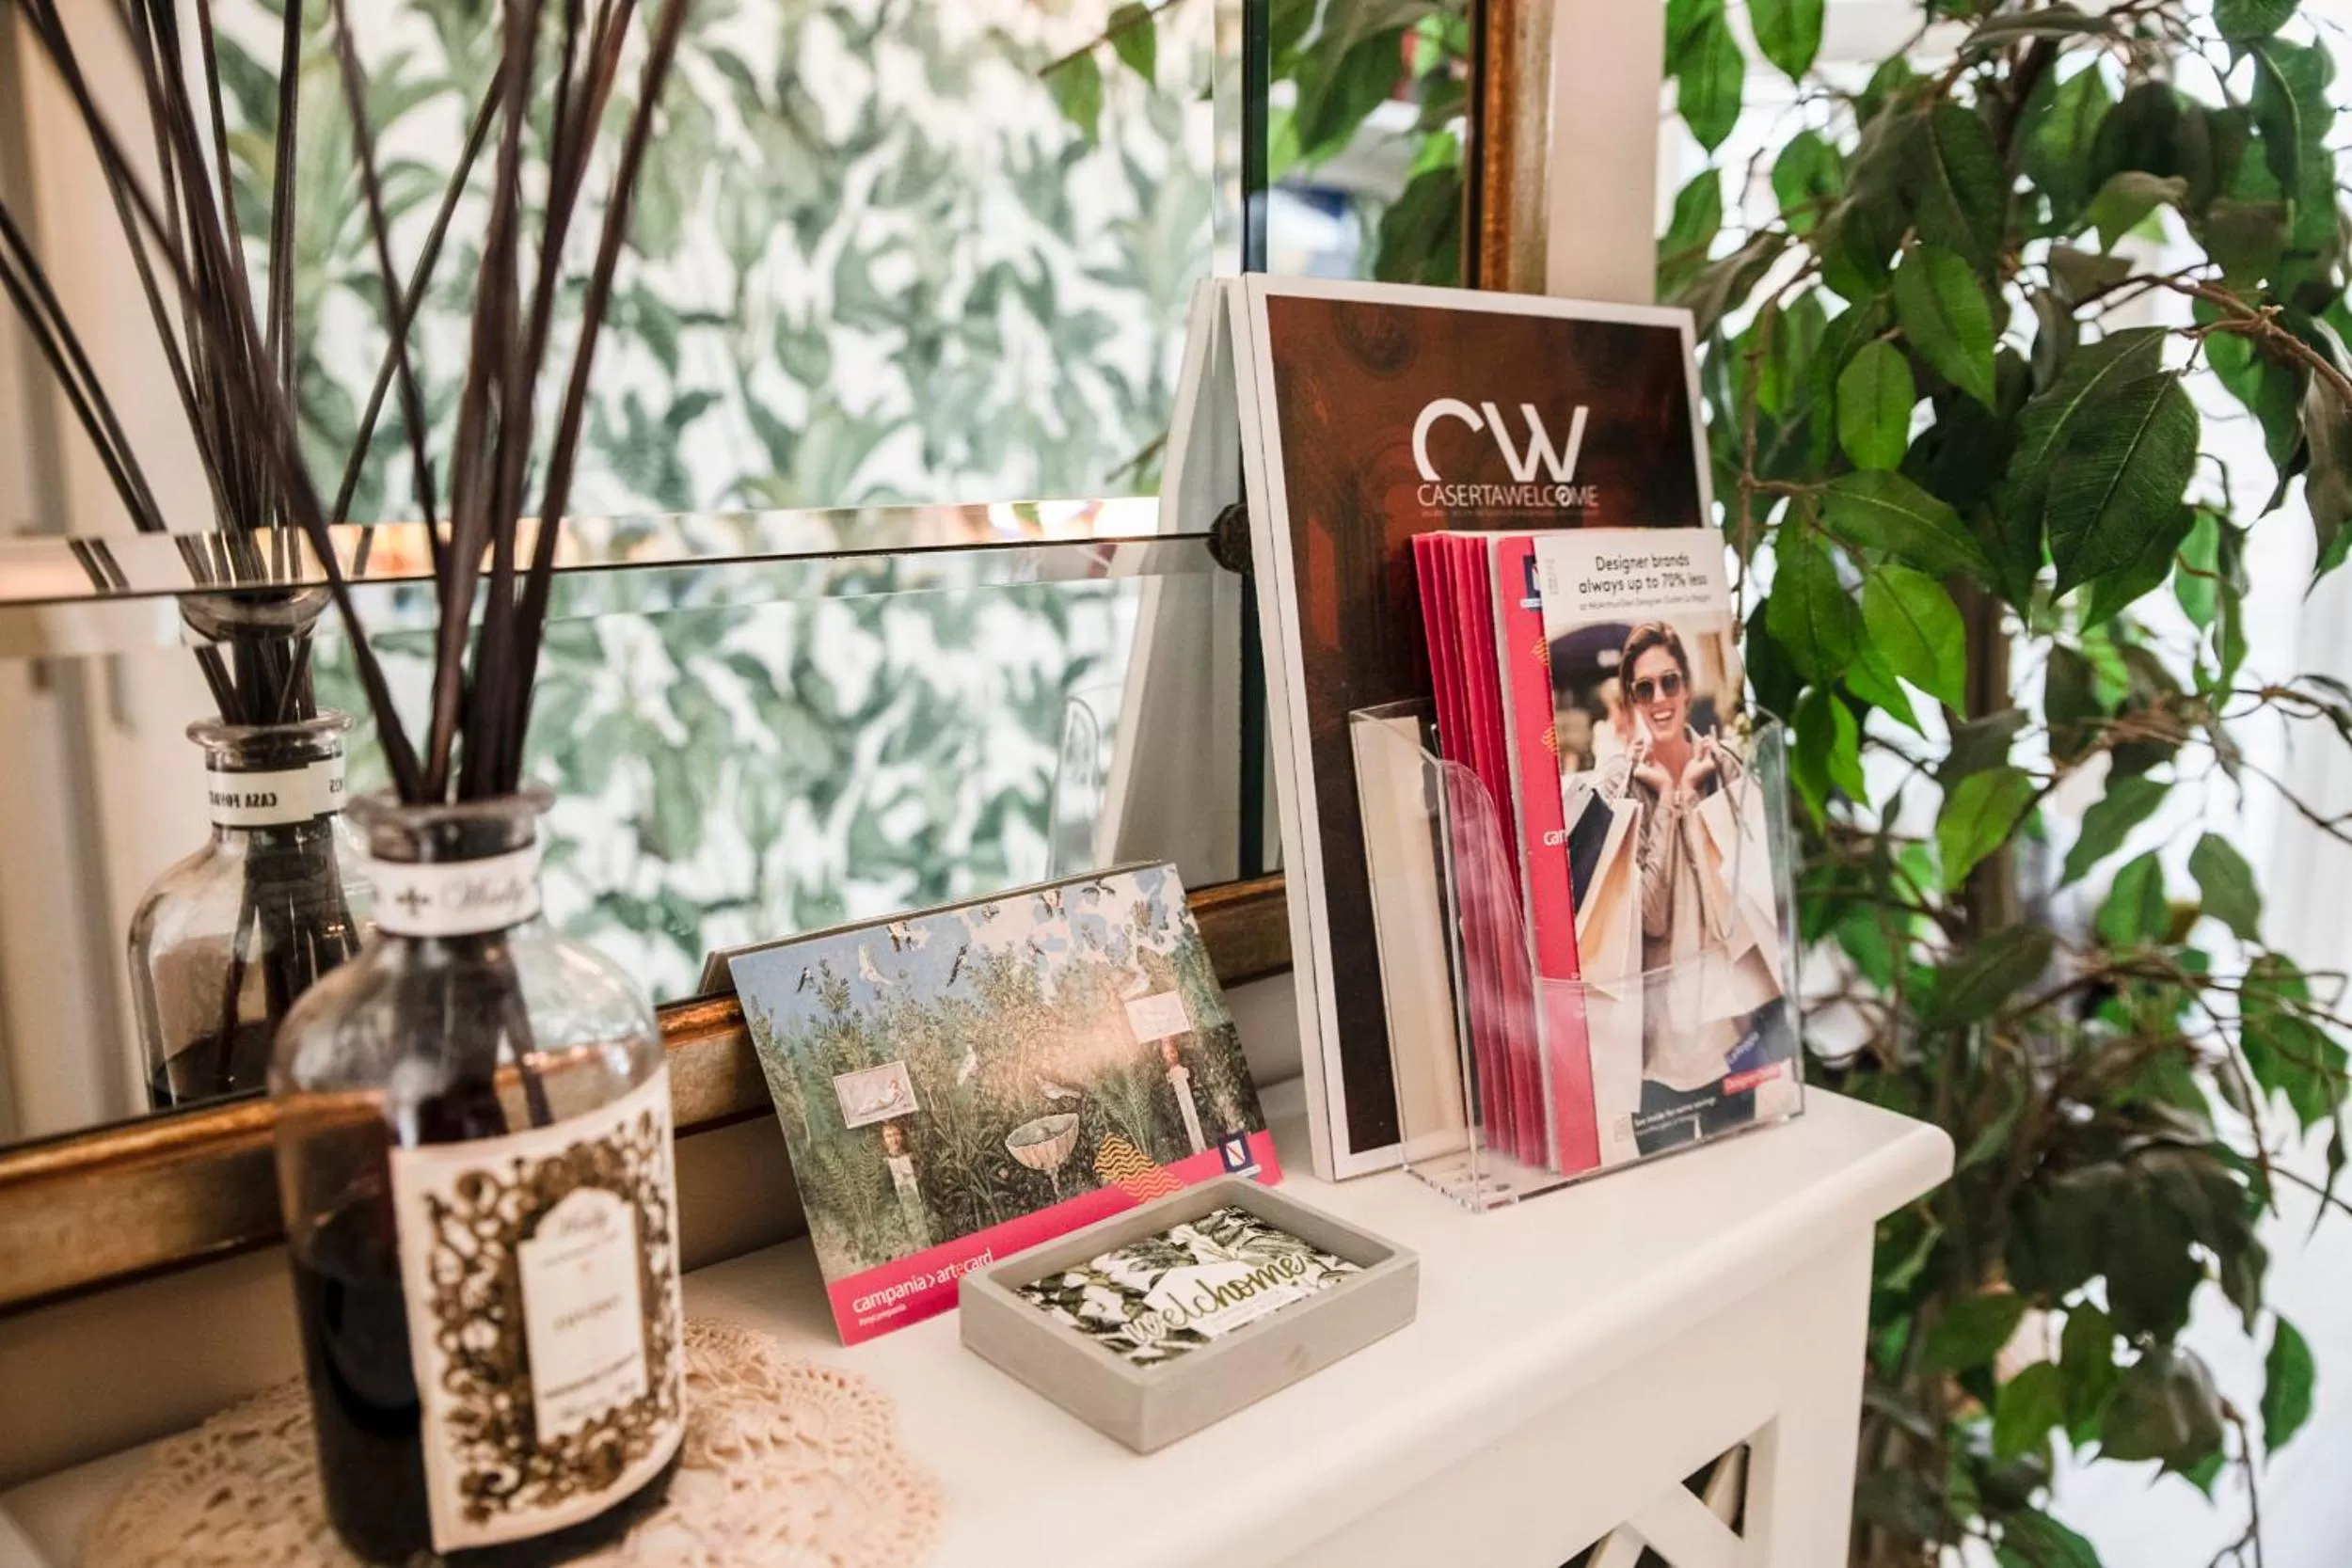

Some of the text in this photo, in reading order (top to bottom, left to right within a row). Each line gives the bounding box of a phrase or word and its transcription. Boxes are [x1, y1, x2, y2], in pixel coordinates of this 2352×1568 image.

[1417, 483, 1599, 508] CASERTAWELCOME
[1596, 552, 1690, 574] Designer brands
[1579, 573, 1708, 595] always up to 70% less
